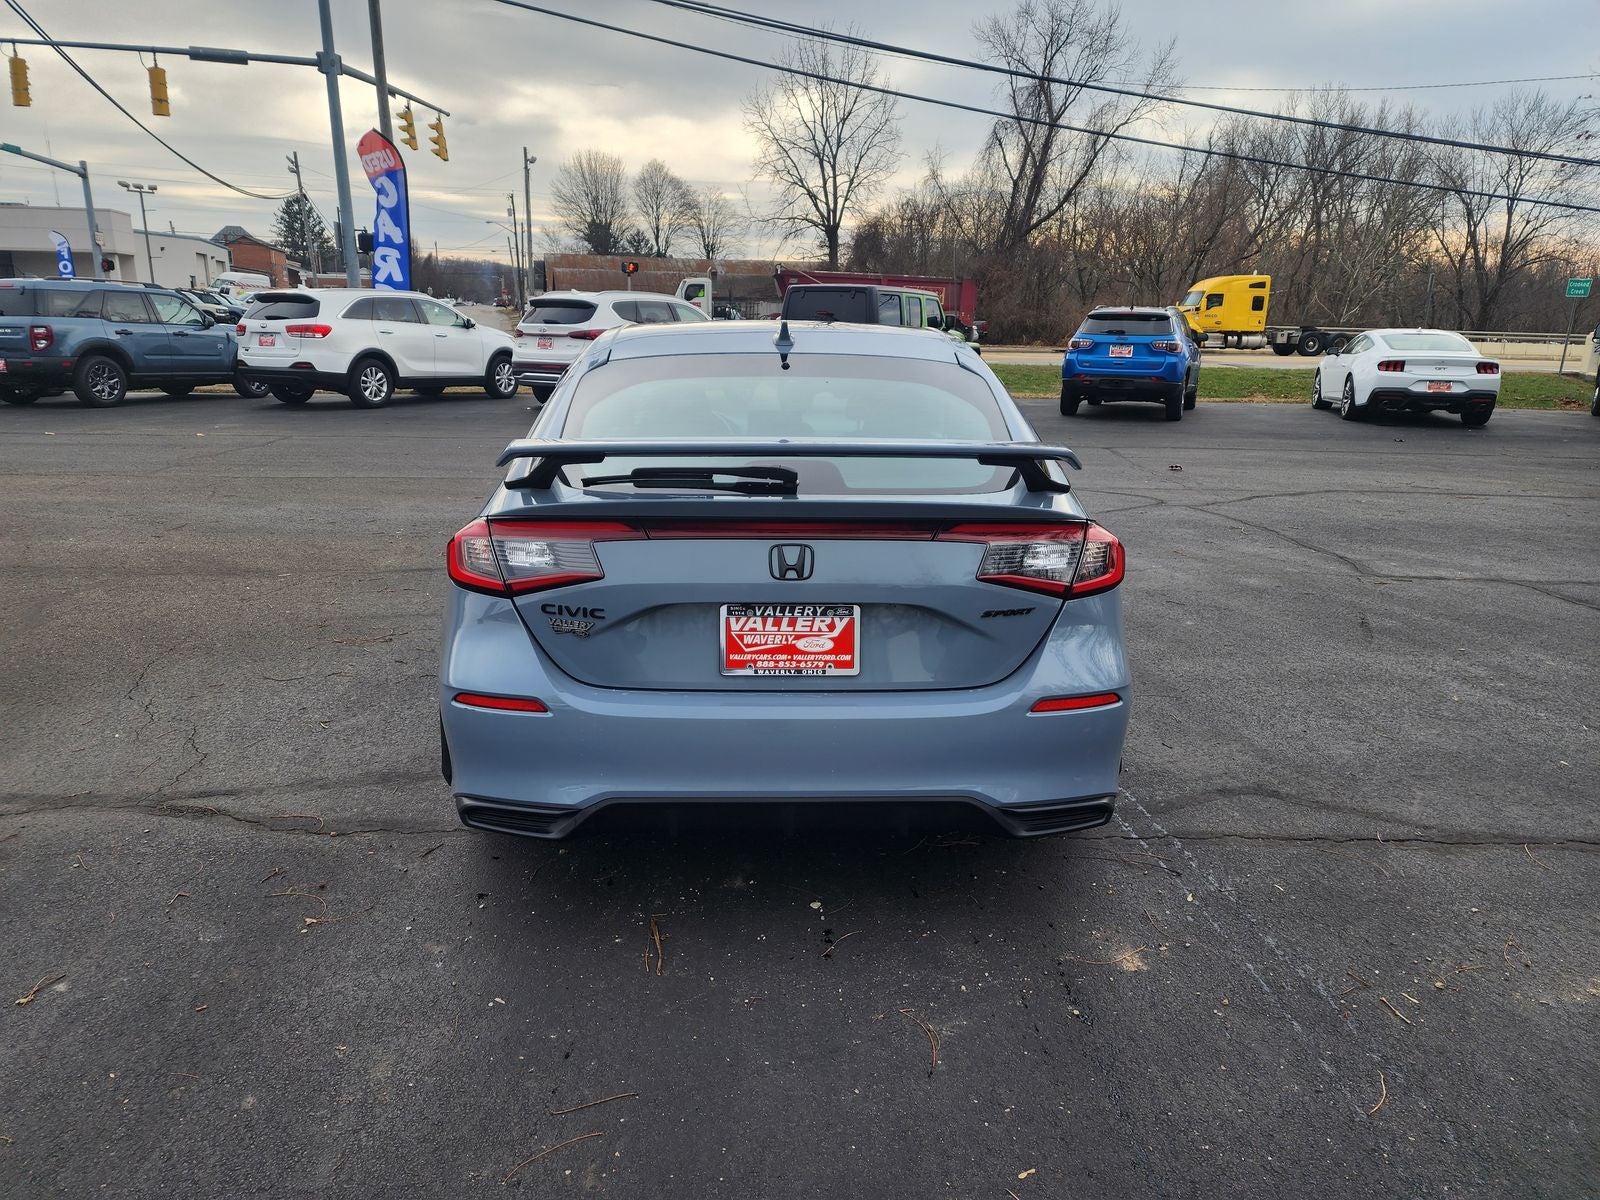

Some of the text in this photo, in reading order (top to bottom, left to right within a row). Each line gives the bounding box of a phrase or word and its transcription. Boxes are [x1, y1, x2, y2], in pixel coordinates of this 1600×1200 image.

[541, 603, 606, 619] CIVIC
[755, 606, 826, 616] VALLERY
[981, 606, 1037, 618] SPORT
[548, 618, 595, 631] VALLERY
[730, 617, 850, 637] VALLERY
[743, 634, 795, 645] WAVERLY
[803, 639, 826, 649] Ford
[756, 660, 825, 668] 888-853-6579
